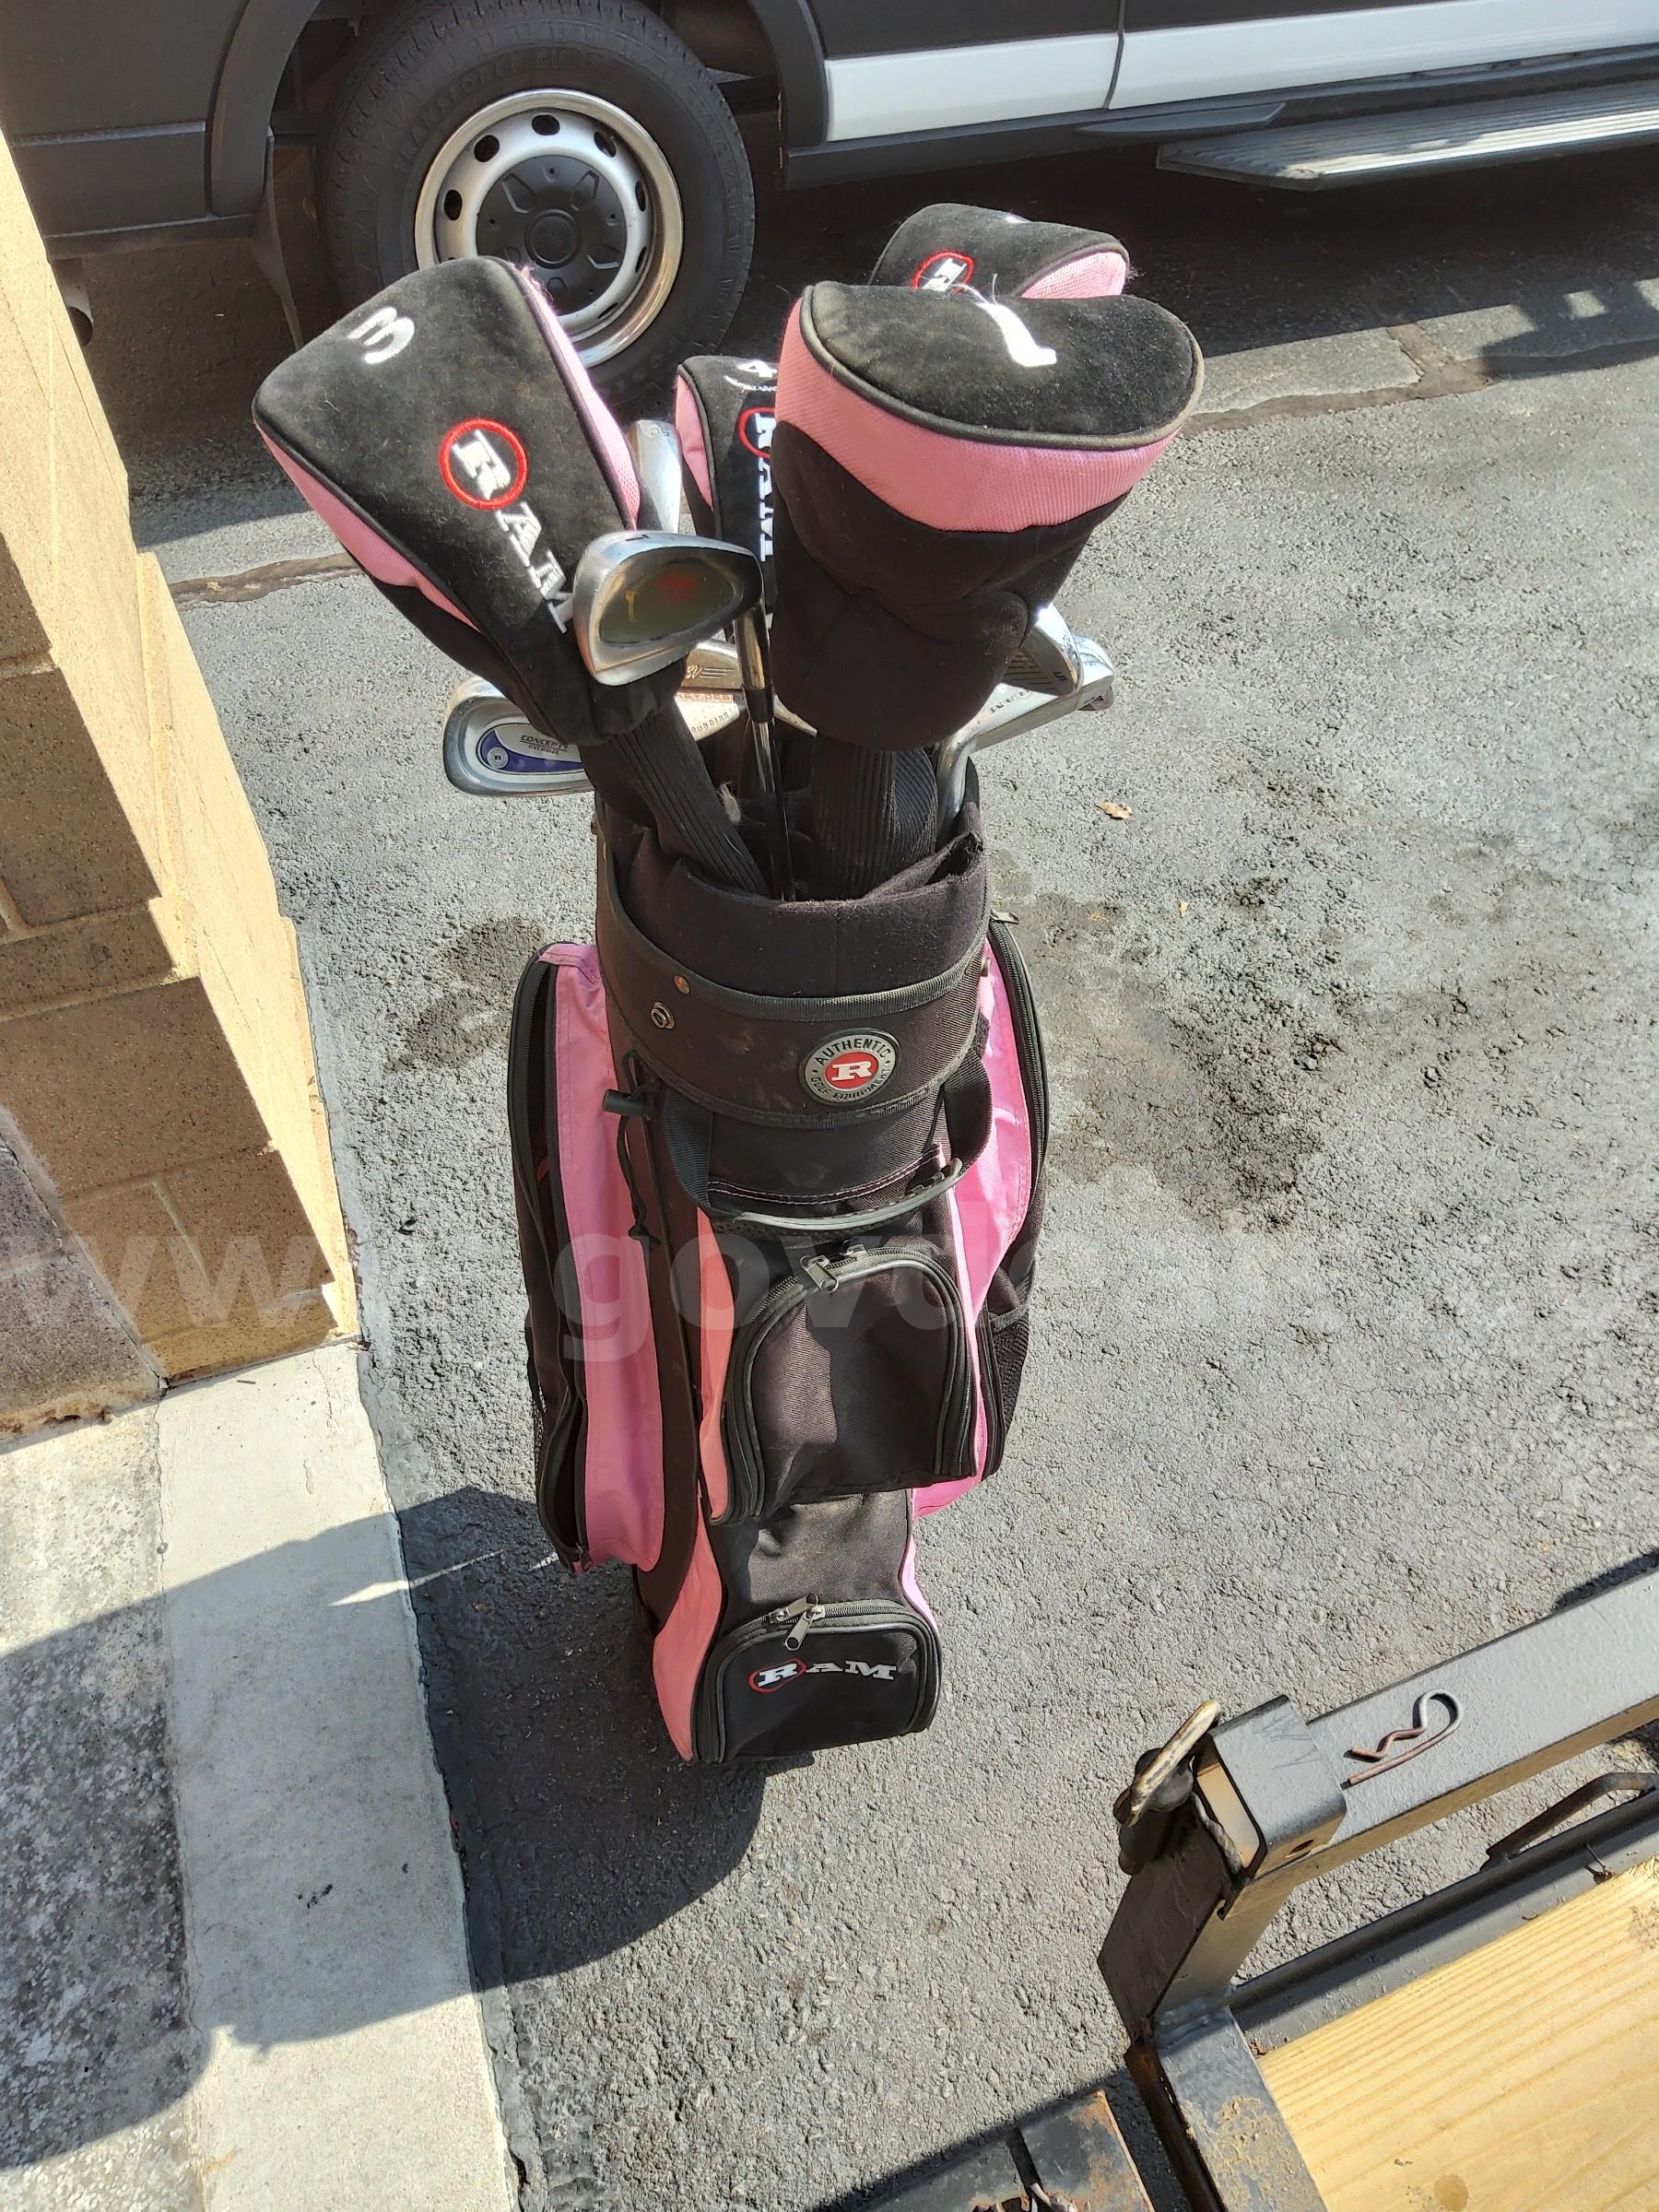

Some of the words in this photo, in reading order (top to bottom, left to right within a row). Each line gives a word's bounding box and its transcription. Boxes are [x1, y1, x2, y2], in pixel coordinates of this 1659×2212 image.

[347, 307, 415, 364] 3
[814, 1038, 892, 1066] AUTHENTIC
[810, 1076, 832, 1096] GOLF
[832, 1067, 890, 1100] EQUIPMENT
[830, 1061, 873, 1082] R
[758, 1661, 898, 1683] RAM
